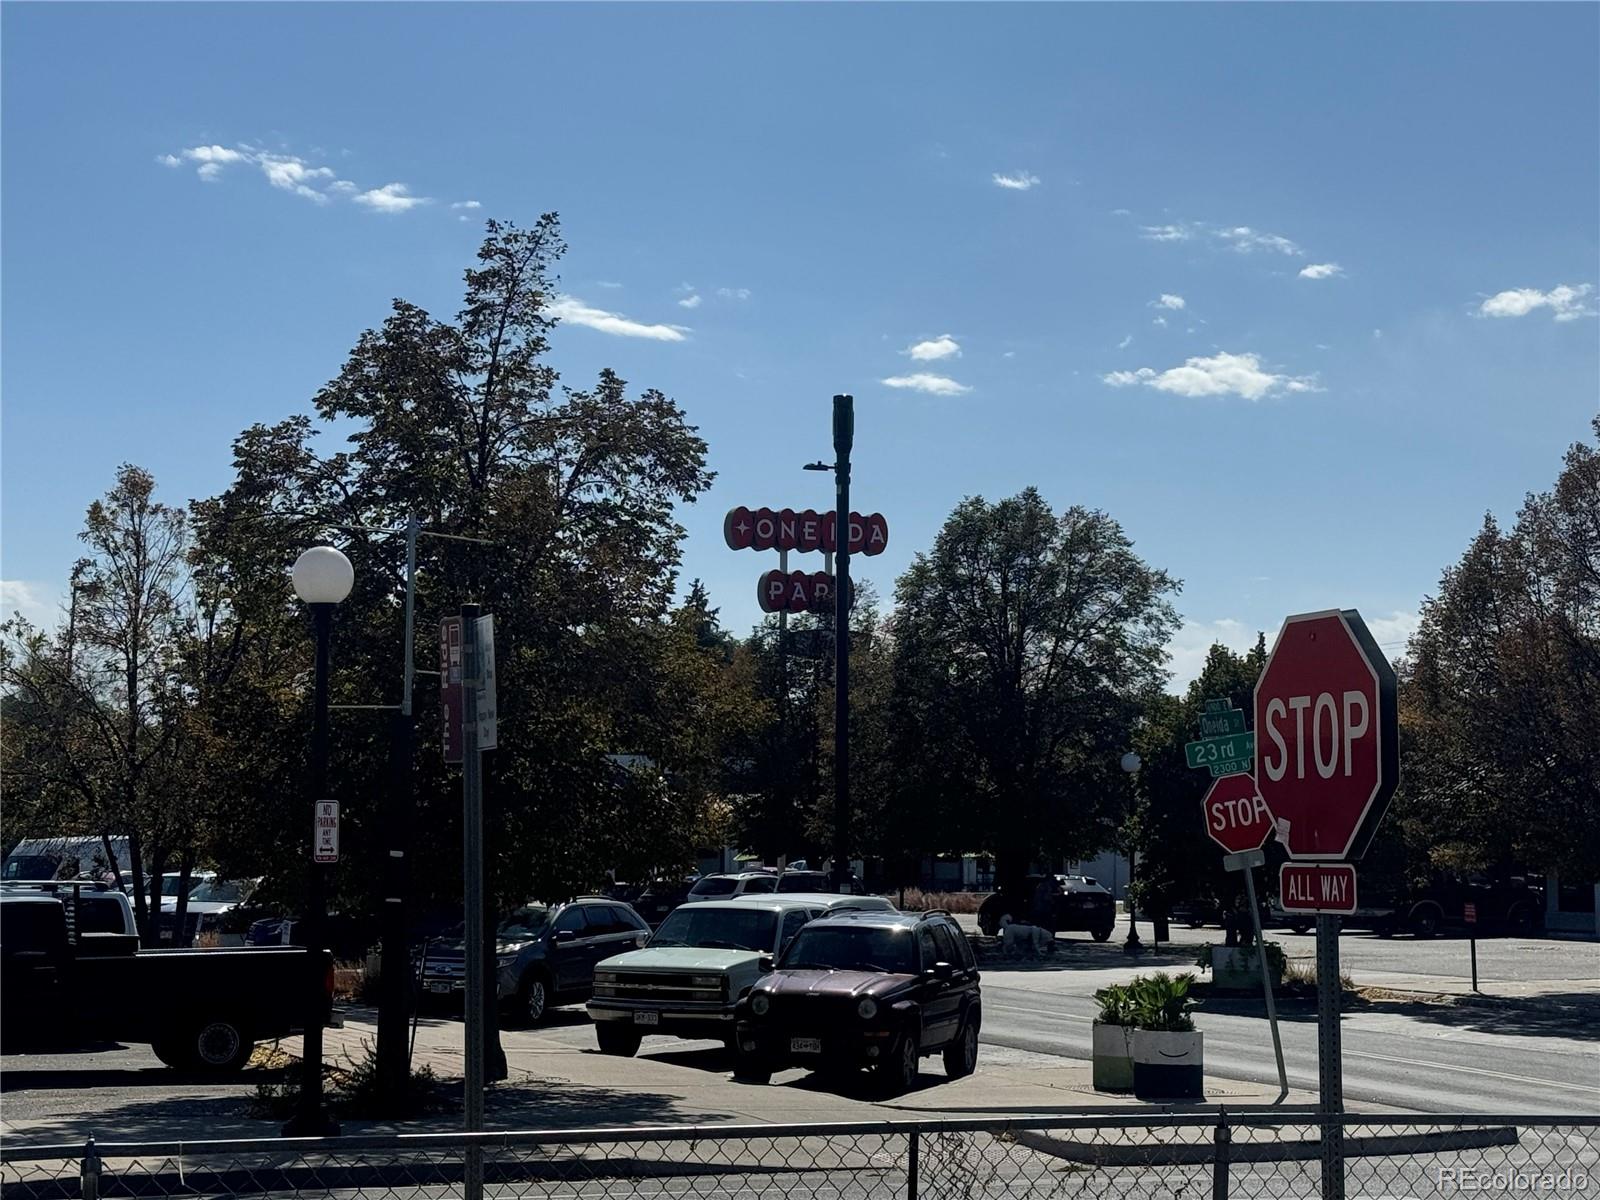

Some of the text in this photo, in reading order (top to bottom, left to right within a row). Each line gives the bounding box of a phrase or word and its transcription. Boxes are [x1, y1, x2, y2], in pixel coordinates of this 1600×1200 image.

[756, 518, 885, 544] ONEIDA
[769, 581, 832, 602] PAR
[1264, 690, 1370, 782] STOP
[1194, 740, 1235, 763] 23rd
[1213, 759, 1248, 774] 2300 N
[322, 804, 333, 816] NO
[1211, 796, 1265, 831] STOP
[318, 817, 337, 828] PARKING
[322, 829, 332, 837] ANY
[1289, 874, 1348, 902] ALL WAY
